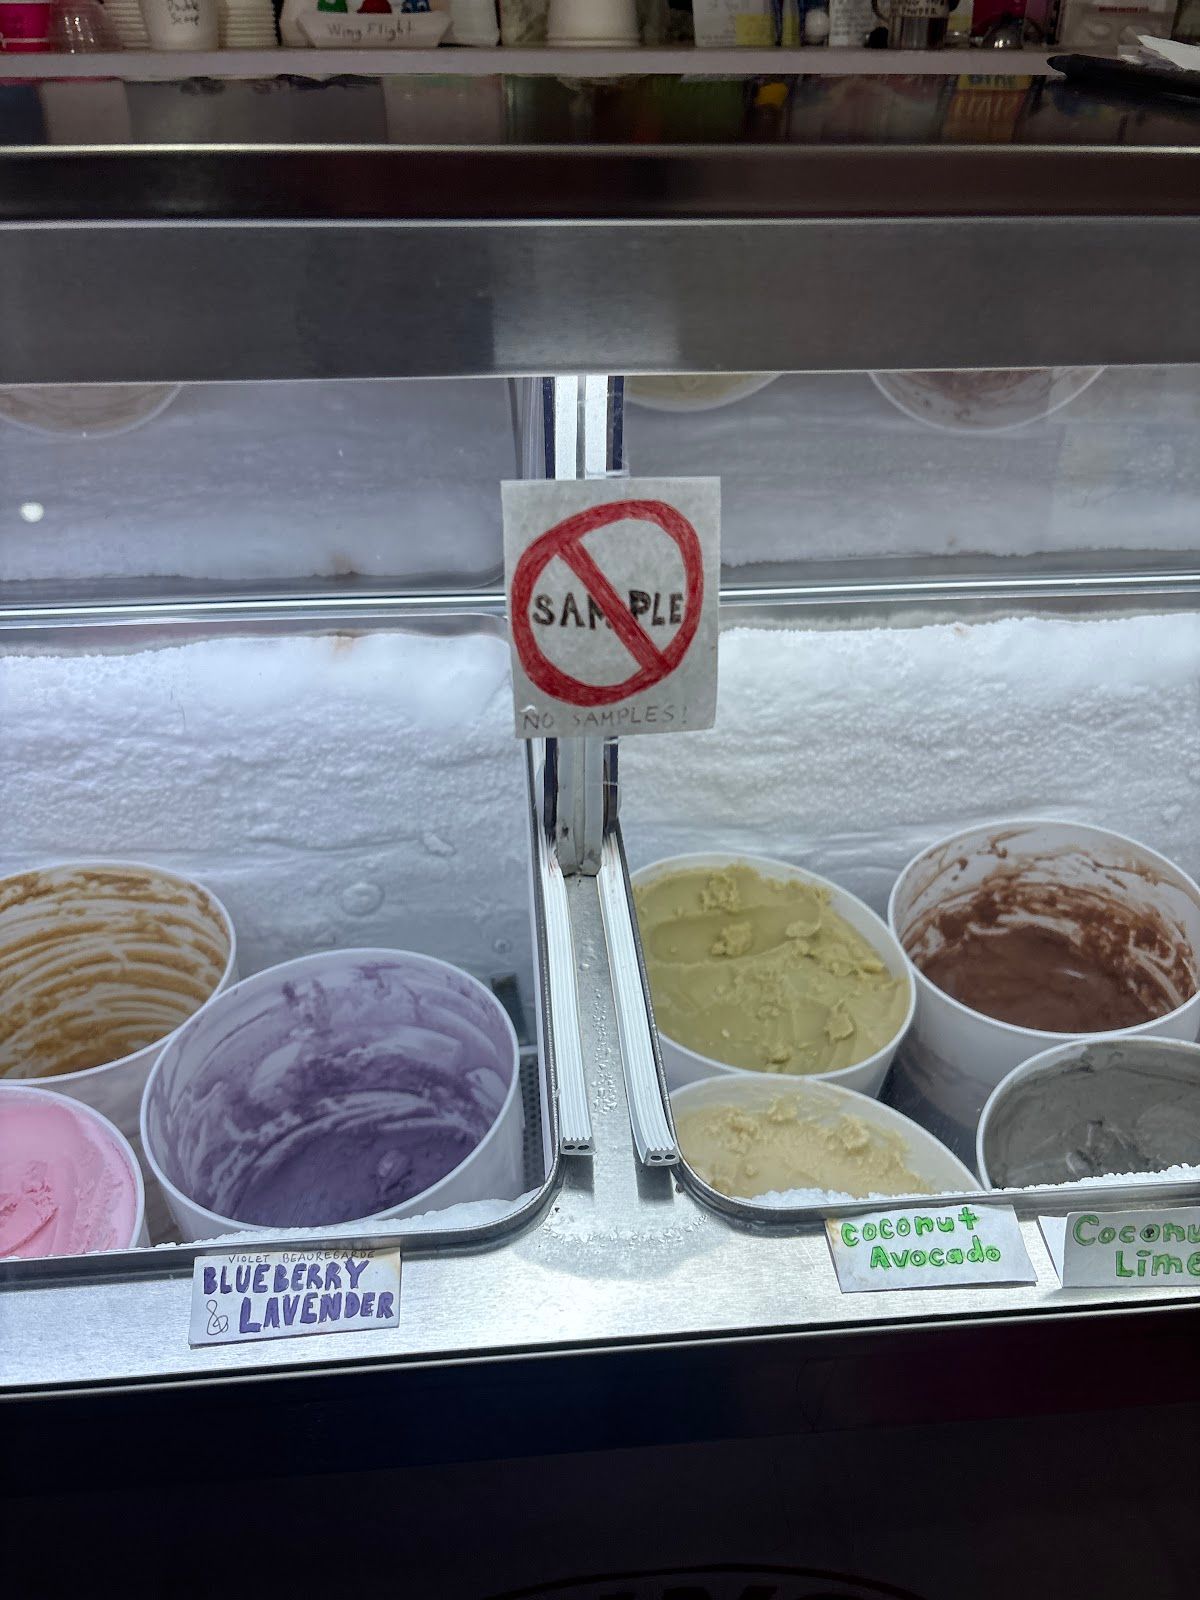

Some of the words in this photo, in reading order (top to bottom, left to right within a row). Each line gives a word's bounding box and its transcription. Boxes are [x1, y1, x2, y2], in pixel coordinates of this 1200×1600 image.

[523, 712, 554, 730] NO
[573, 705, 688, 728] SAMPLES!
[228, 1254, 270, 1264] VIOLET
[282, 1250, 375, 1263] BEAUREGARDE
[870, 1235, 1001, 1269] Avocado
[1115, 1249, 1200, 1277] Lime
[203, 1257, 369, 1295] BLUEBERRY
[239, 1291, 394, 1334] LAVENDER
